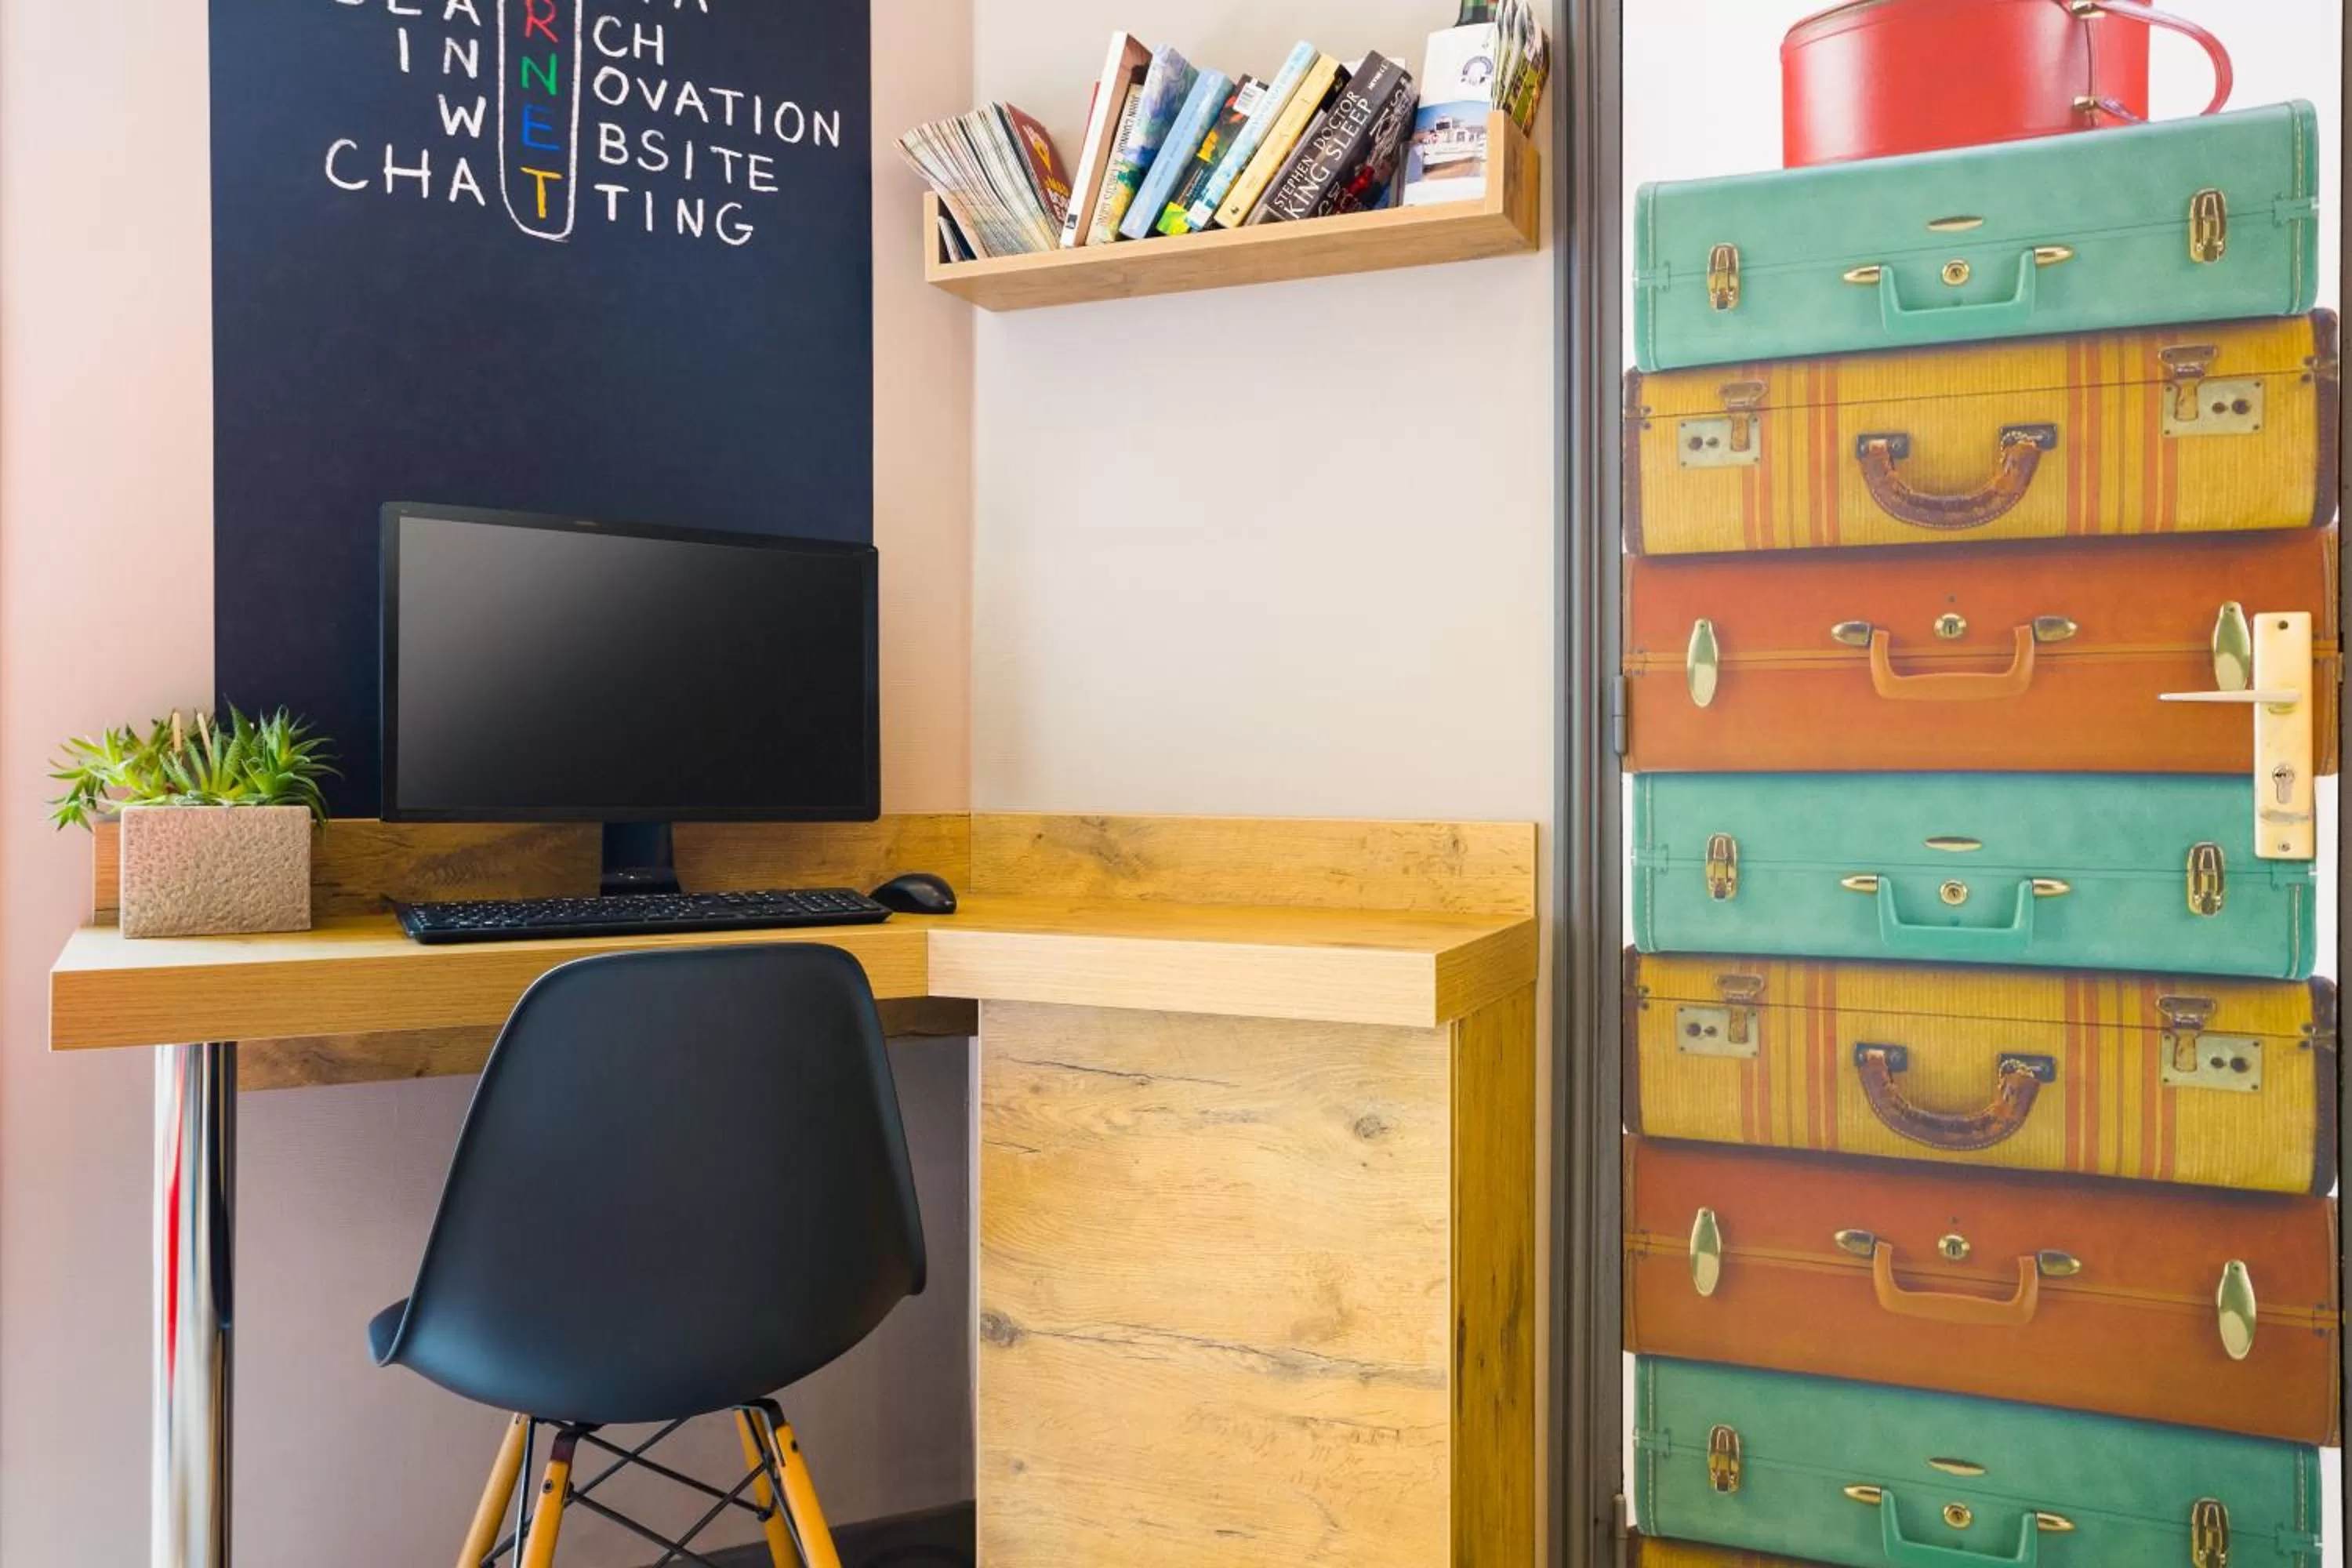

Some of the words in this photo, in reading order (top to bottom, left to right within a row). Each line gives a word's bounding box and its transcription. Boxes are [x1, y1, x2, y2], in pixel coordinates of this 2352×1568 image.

[1313, 90, 1360, 151] DOCTOR
[1325, 97, 1373, 161] SLEEP
[1274, 154, 1314, 209] STEPHEN
[1283, 162, 1330, 220] KING
